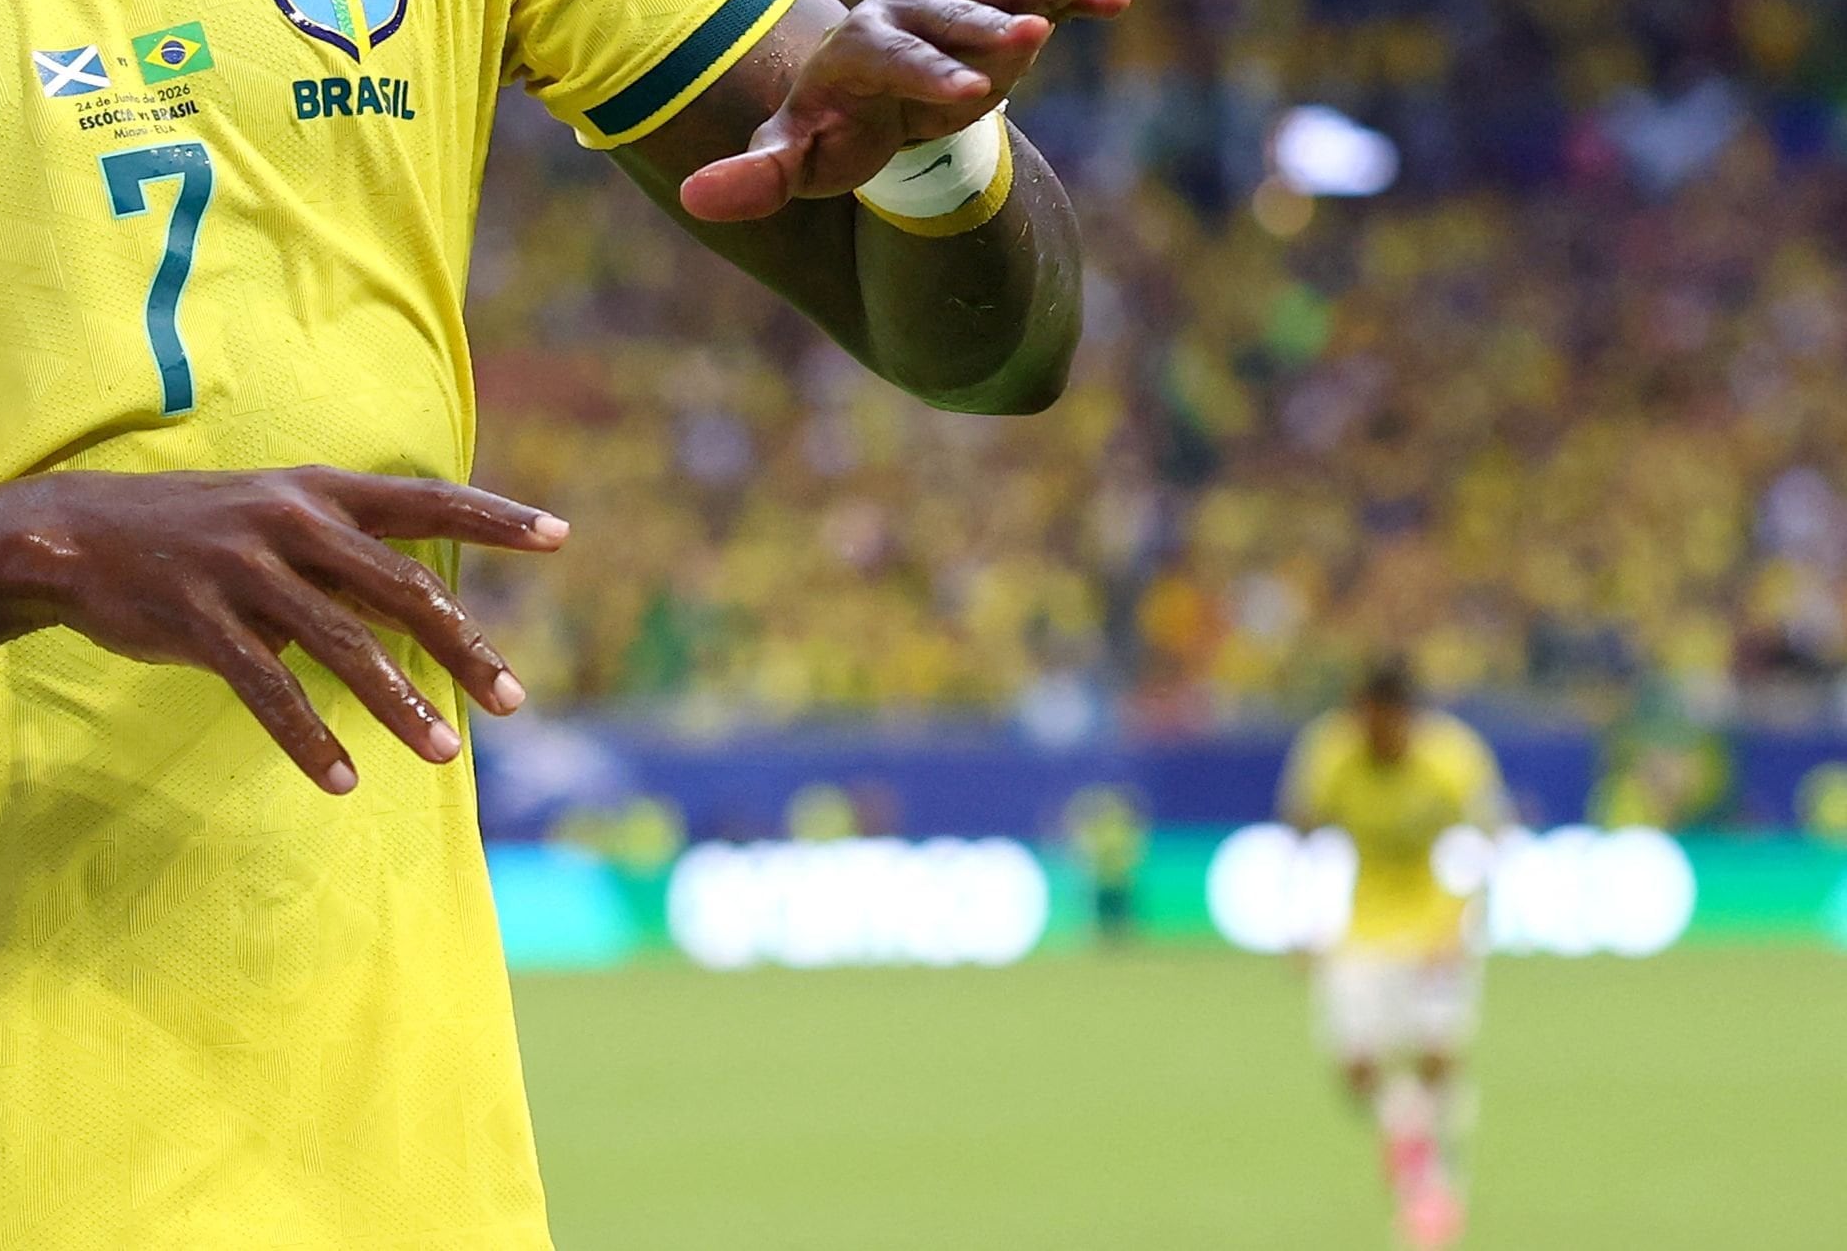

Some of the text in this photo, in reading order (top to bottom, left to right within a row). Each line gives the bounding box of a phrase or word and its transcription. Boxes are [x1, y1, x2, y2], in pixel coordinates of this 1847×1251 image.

[75, 102, 92, 113] 24
[96, 96, 111, 107] de
[157, 83, 191, 102] 2026
[151, 100, 200, 122] BRASIL
[292, 76, 416, 121] BRASIL
[97, 141, 216, 416] 7
